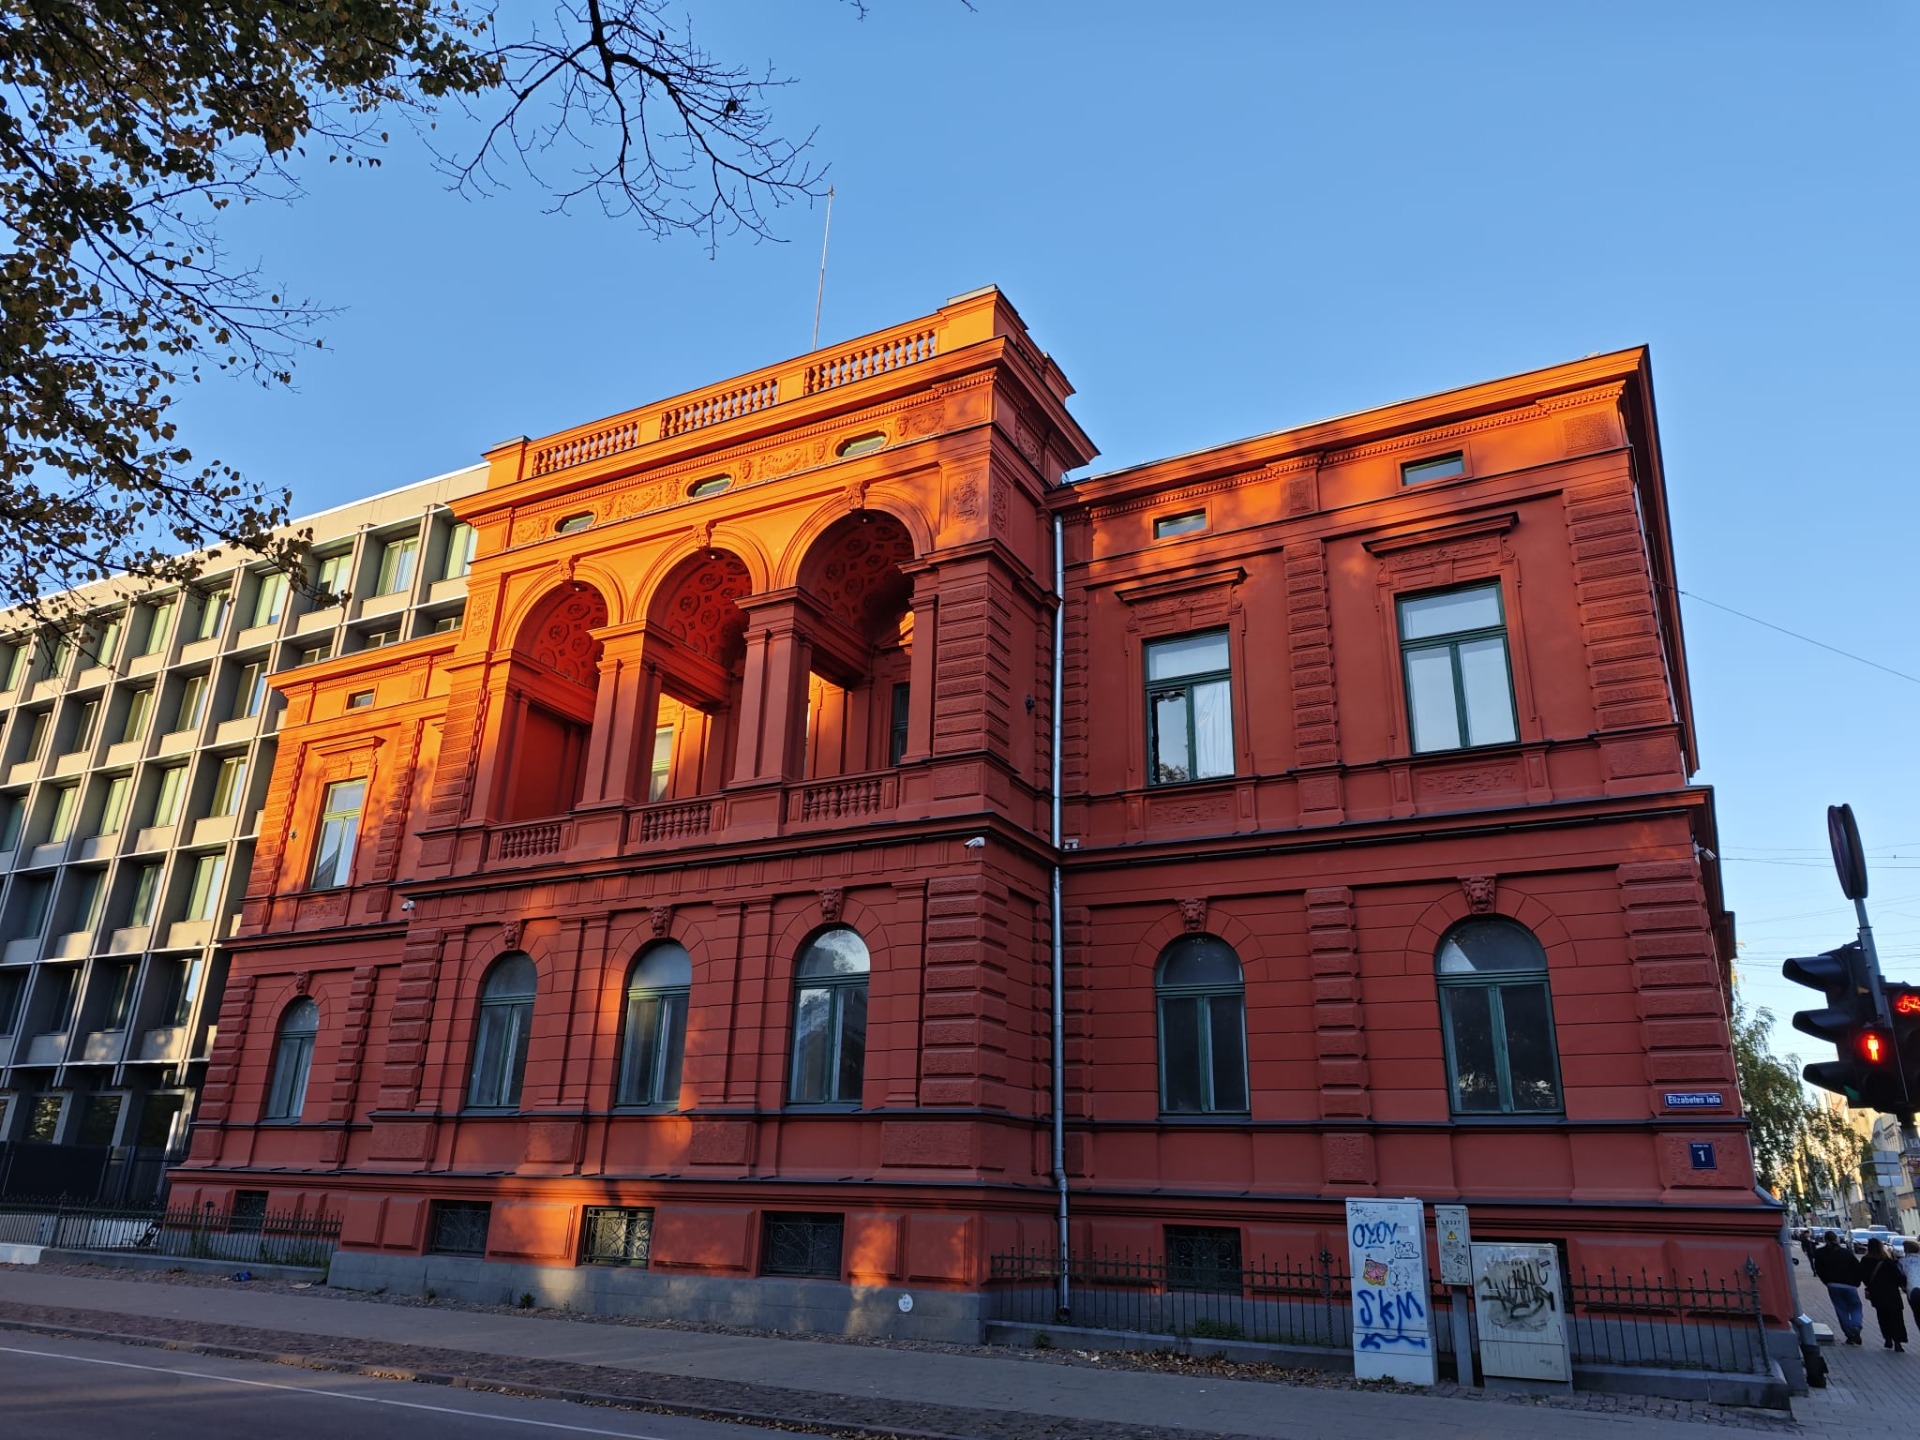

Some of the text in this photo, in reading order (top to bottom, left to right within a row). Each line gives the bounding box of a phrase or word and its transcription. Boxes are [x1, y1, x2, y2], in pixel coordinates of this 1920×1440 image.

[1668, 1095, 1721, 1104] Elizabetes iela
[1698, 1149, 1705, 1162] 1
